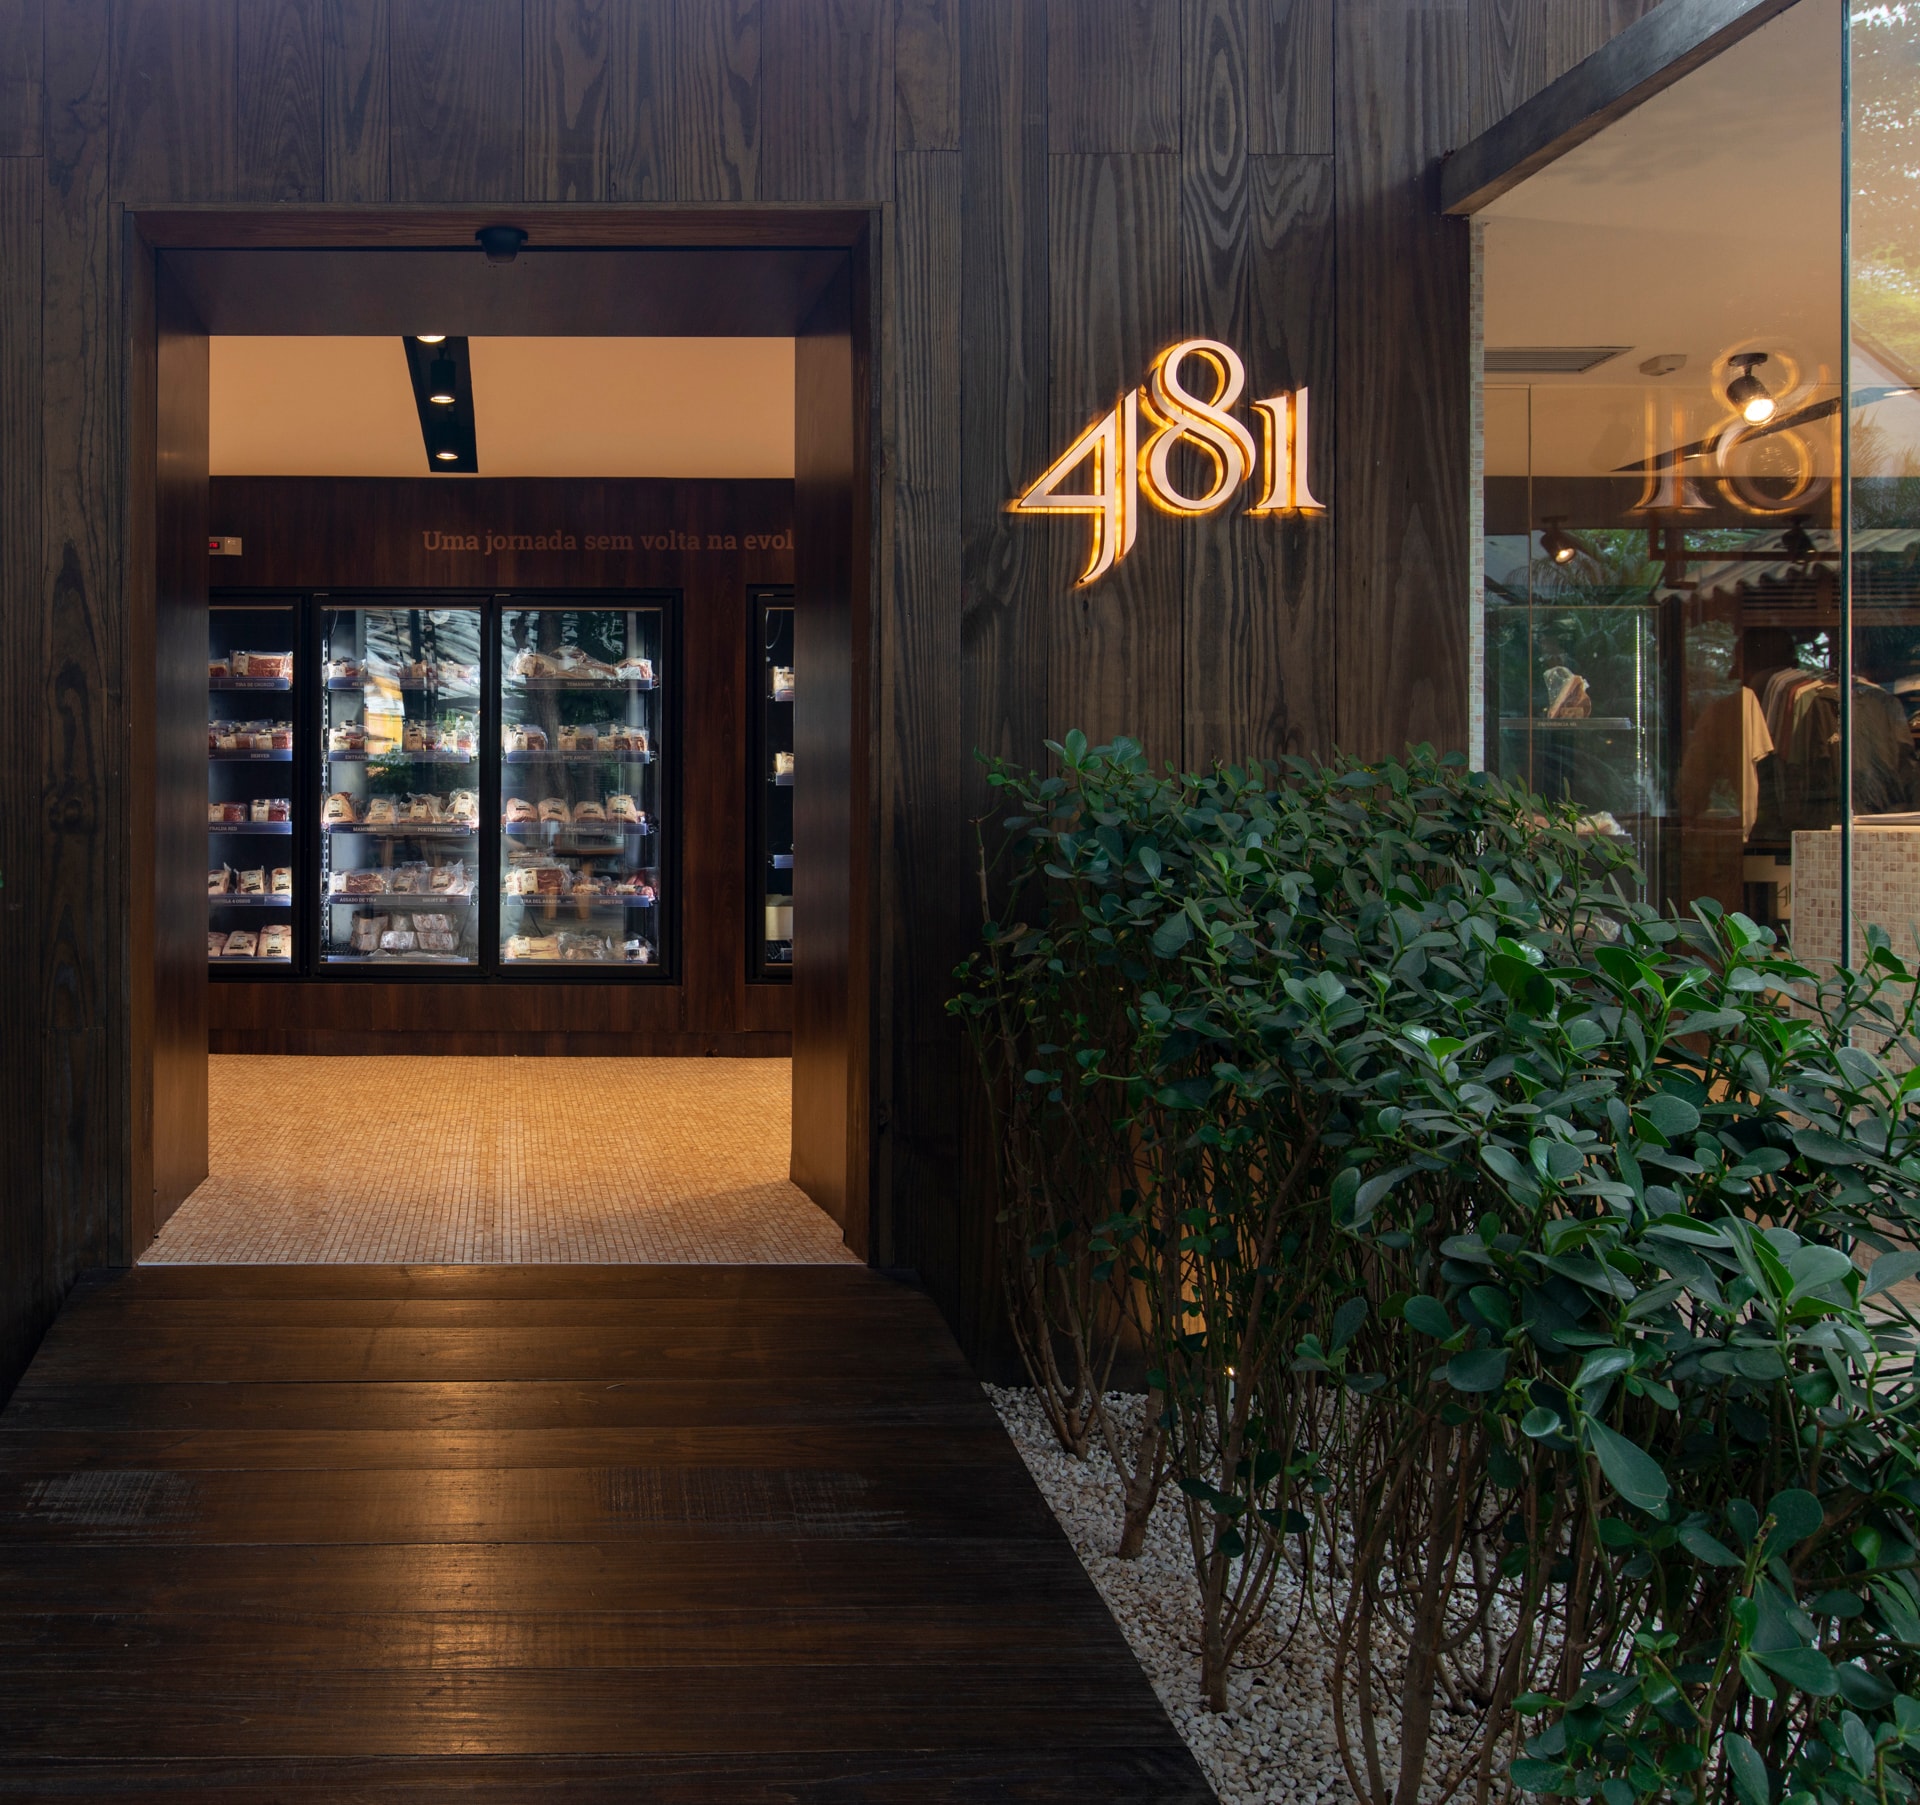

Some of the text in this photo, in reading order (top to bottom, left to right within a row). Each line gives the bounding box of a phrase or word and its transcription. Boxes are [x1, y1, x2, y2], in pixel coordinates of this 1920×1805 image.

[1004, 337, 1327, 589] 481
[422, 529, 795, 556] Uma jornada sem volta na evol
